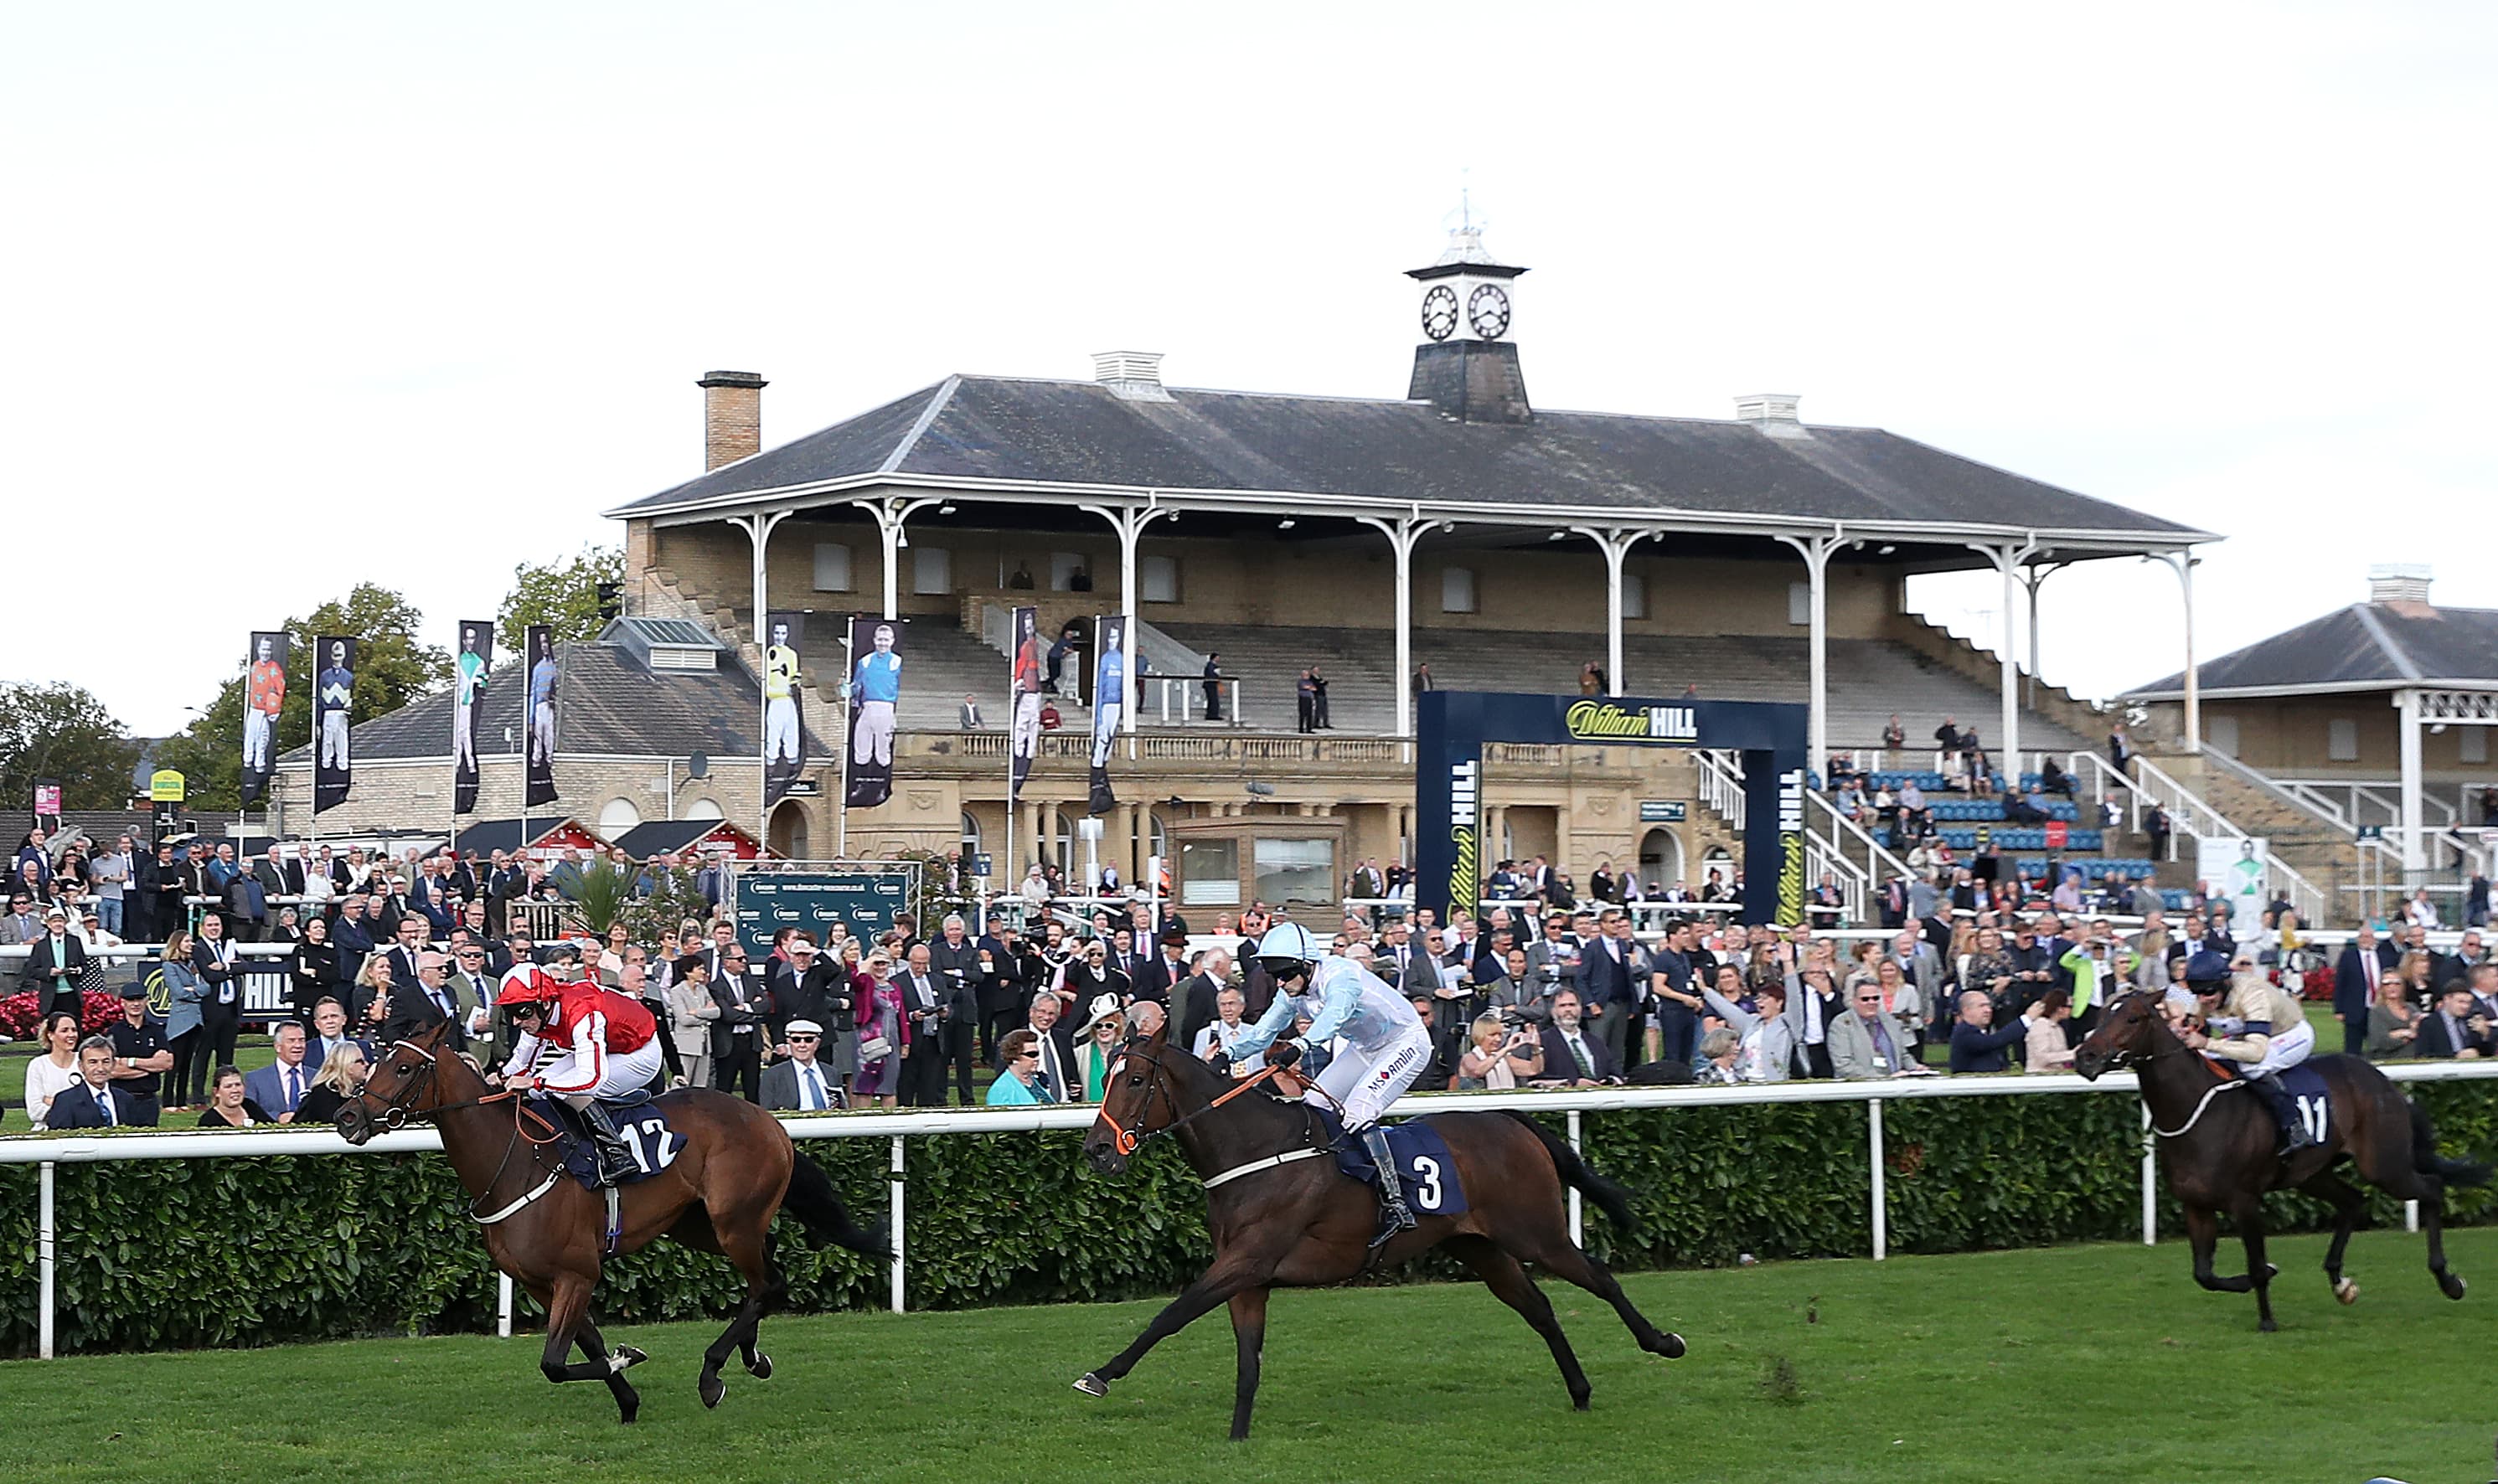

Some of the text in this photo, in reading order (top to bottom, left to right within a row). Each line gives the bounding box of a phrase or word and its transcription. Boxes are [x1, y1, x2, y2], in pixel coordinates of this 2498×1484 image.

[1566, 700, 1698, 738] William HILL
[1451, 760, 1476, 825] HILL
[1778, 768, 1803, 831] HILL
[1367, 1077, 1386, 1093] MS
[2295, 1095, 2328, 1143] 11
[620, 1119, 677, 1173] 12
[1413, 1156, 1442, 1209] 3
